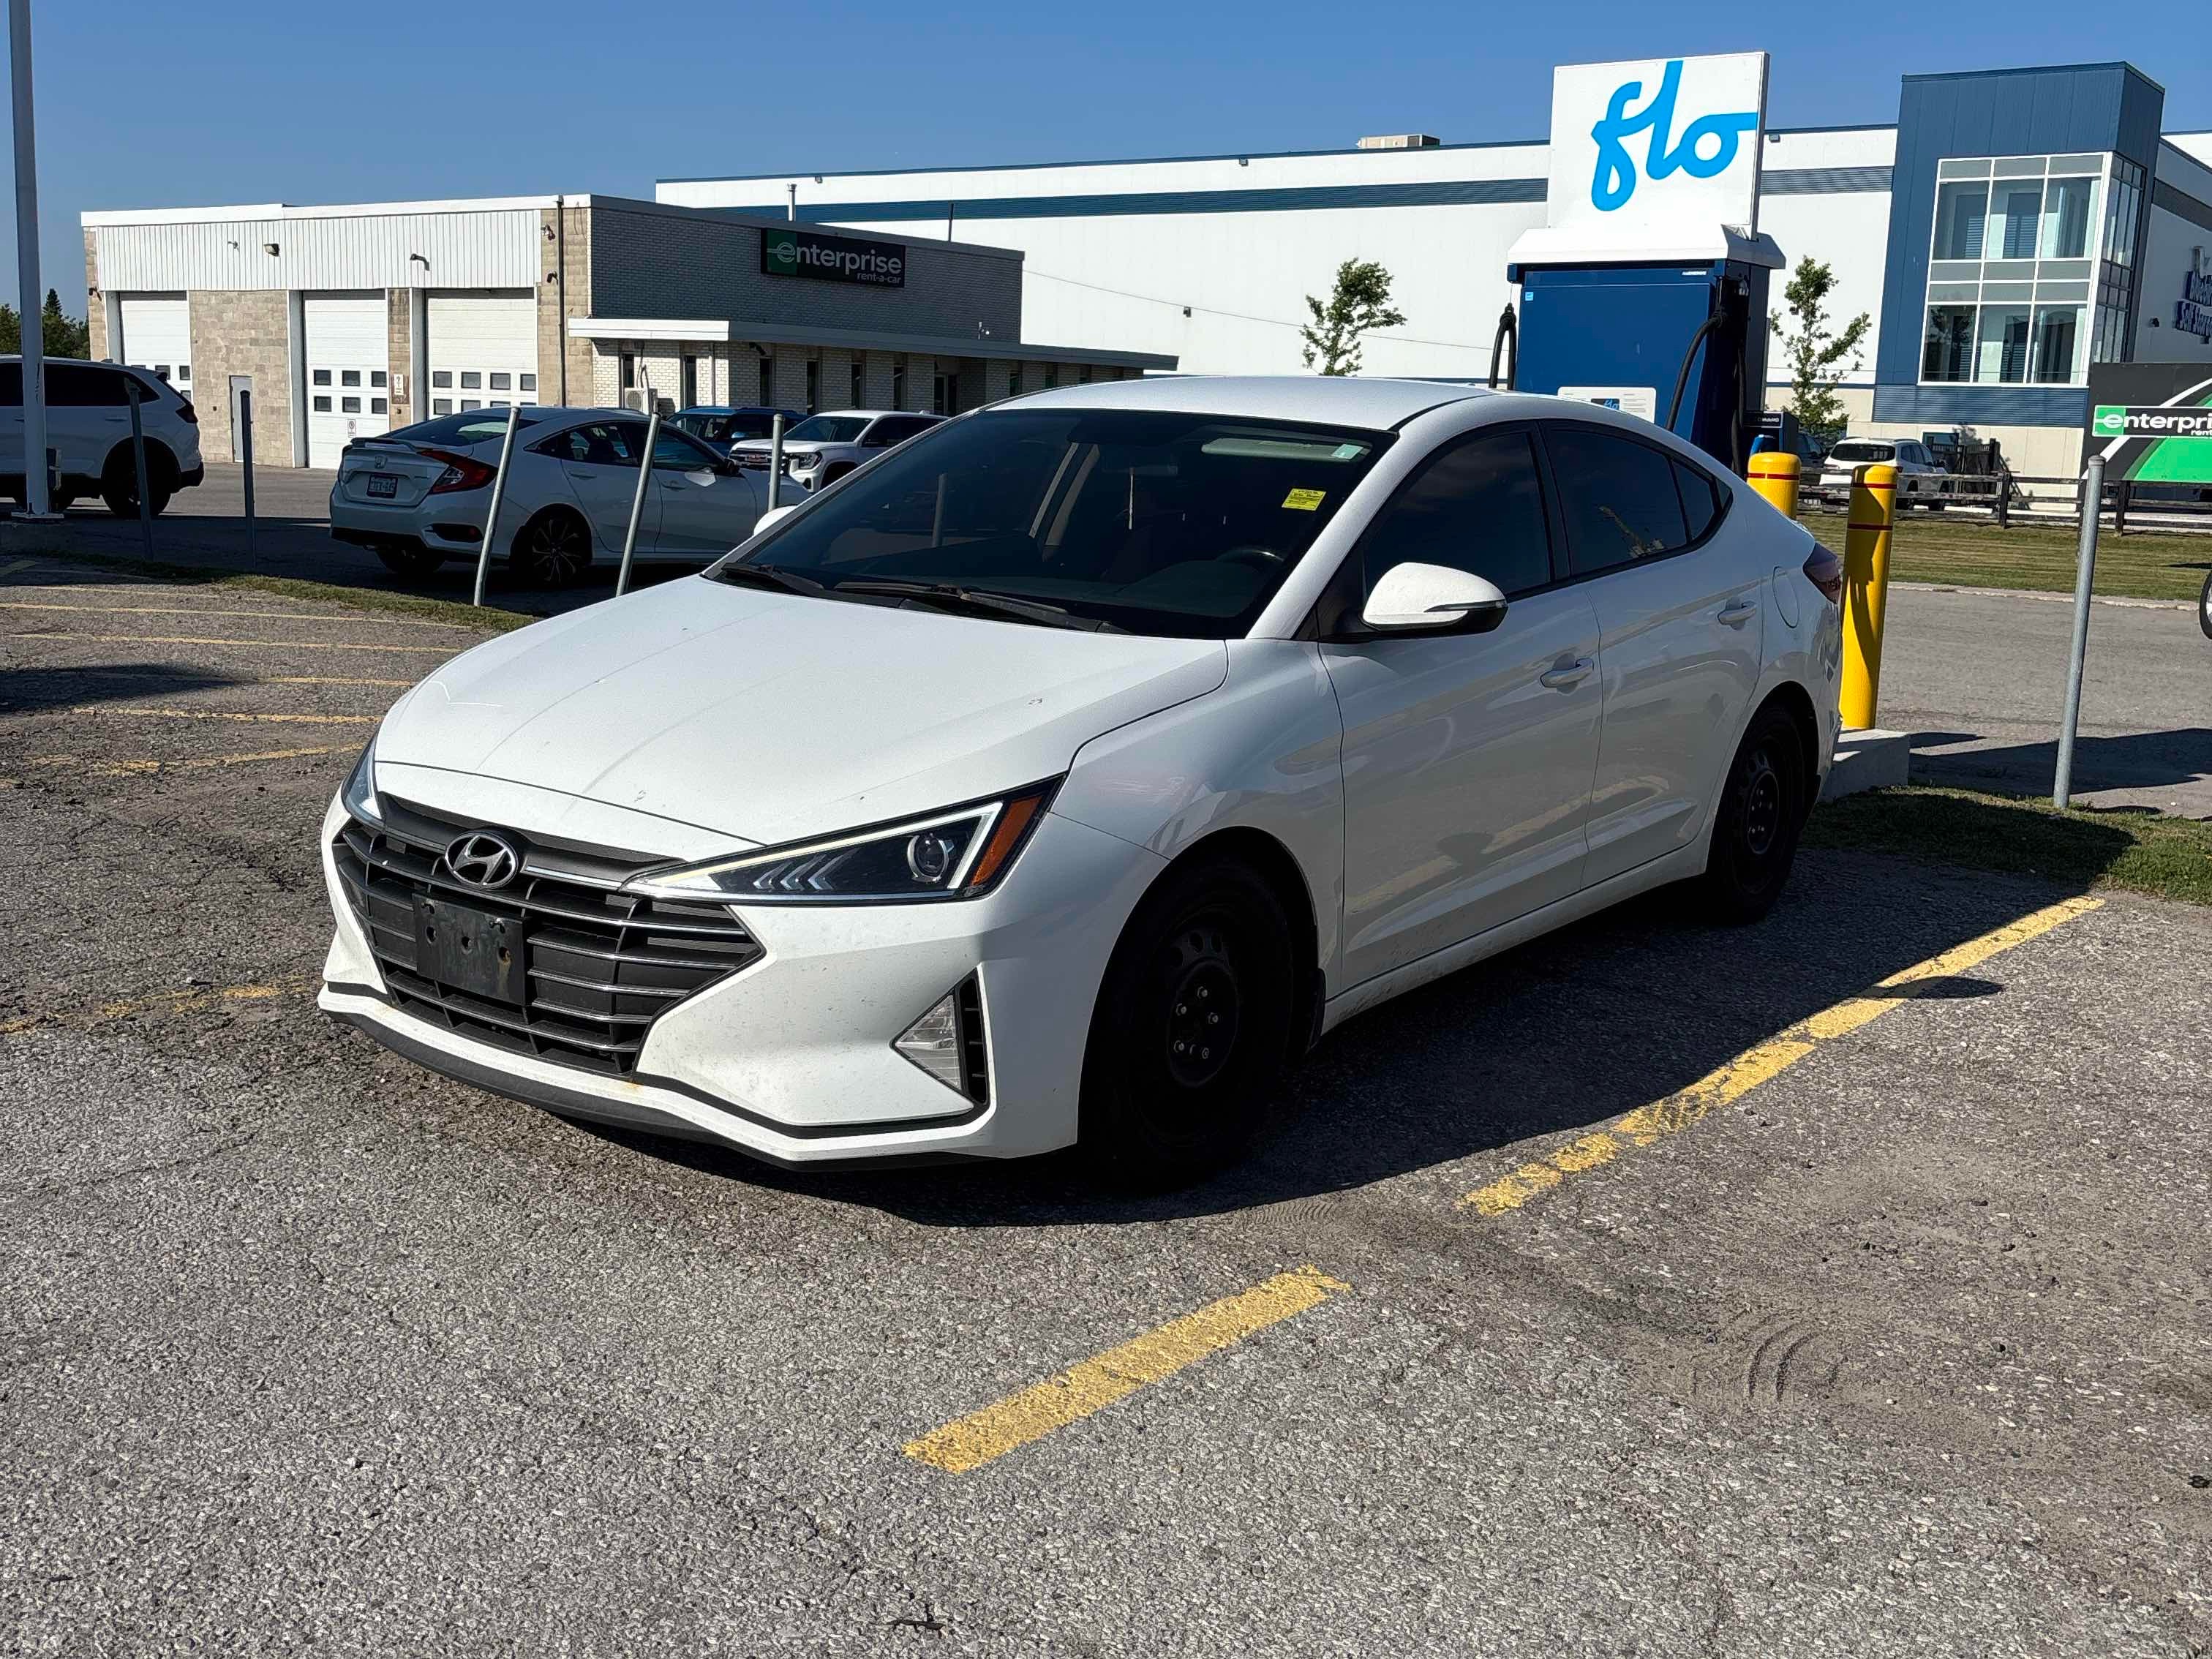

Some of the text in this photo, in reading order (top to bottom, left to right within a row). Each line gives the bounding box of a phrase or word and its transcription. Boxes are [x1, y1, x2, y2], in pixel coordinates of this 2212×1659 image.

[1591, 60, 1758, 211] flo
[768, 241, 902, 275] enterprise
[857, 272, 902, 284] rent-a-car
